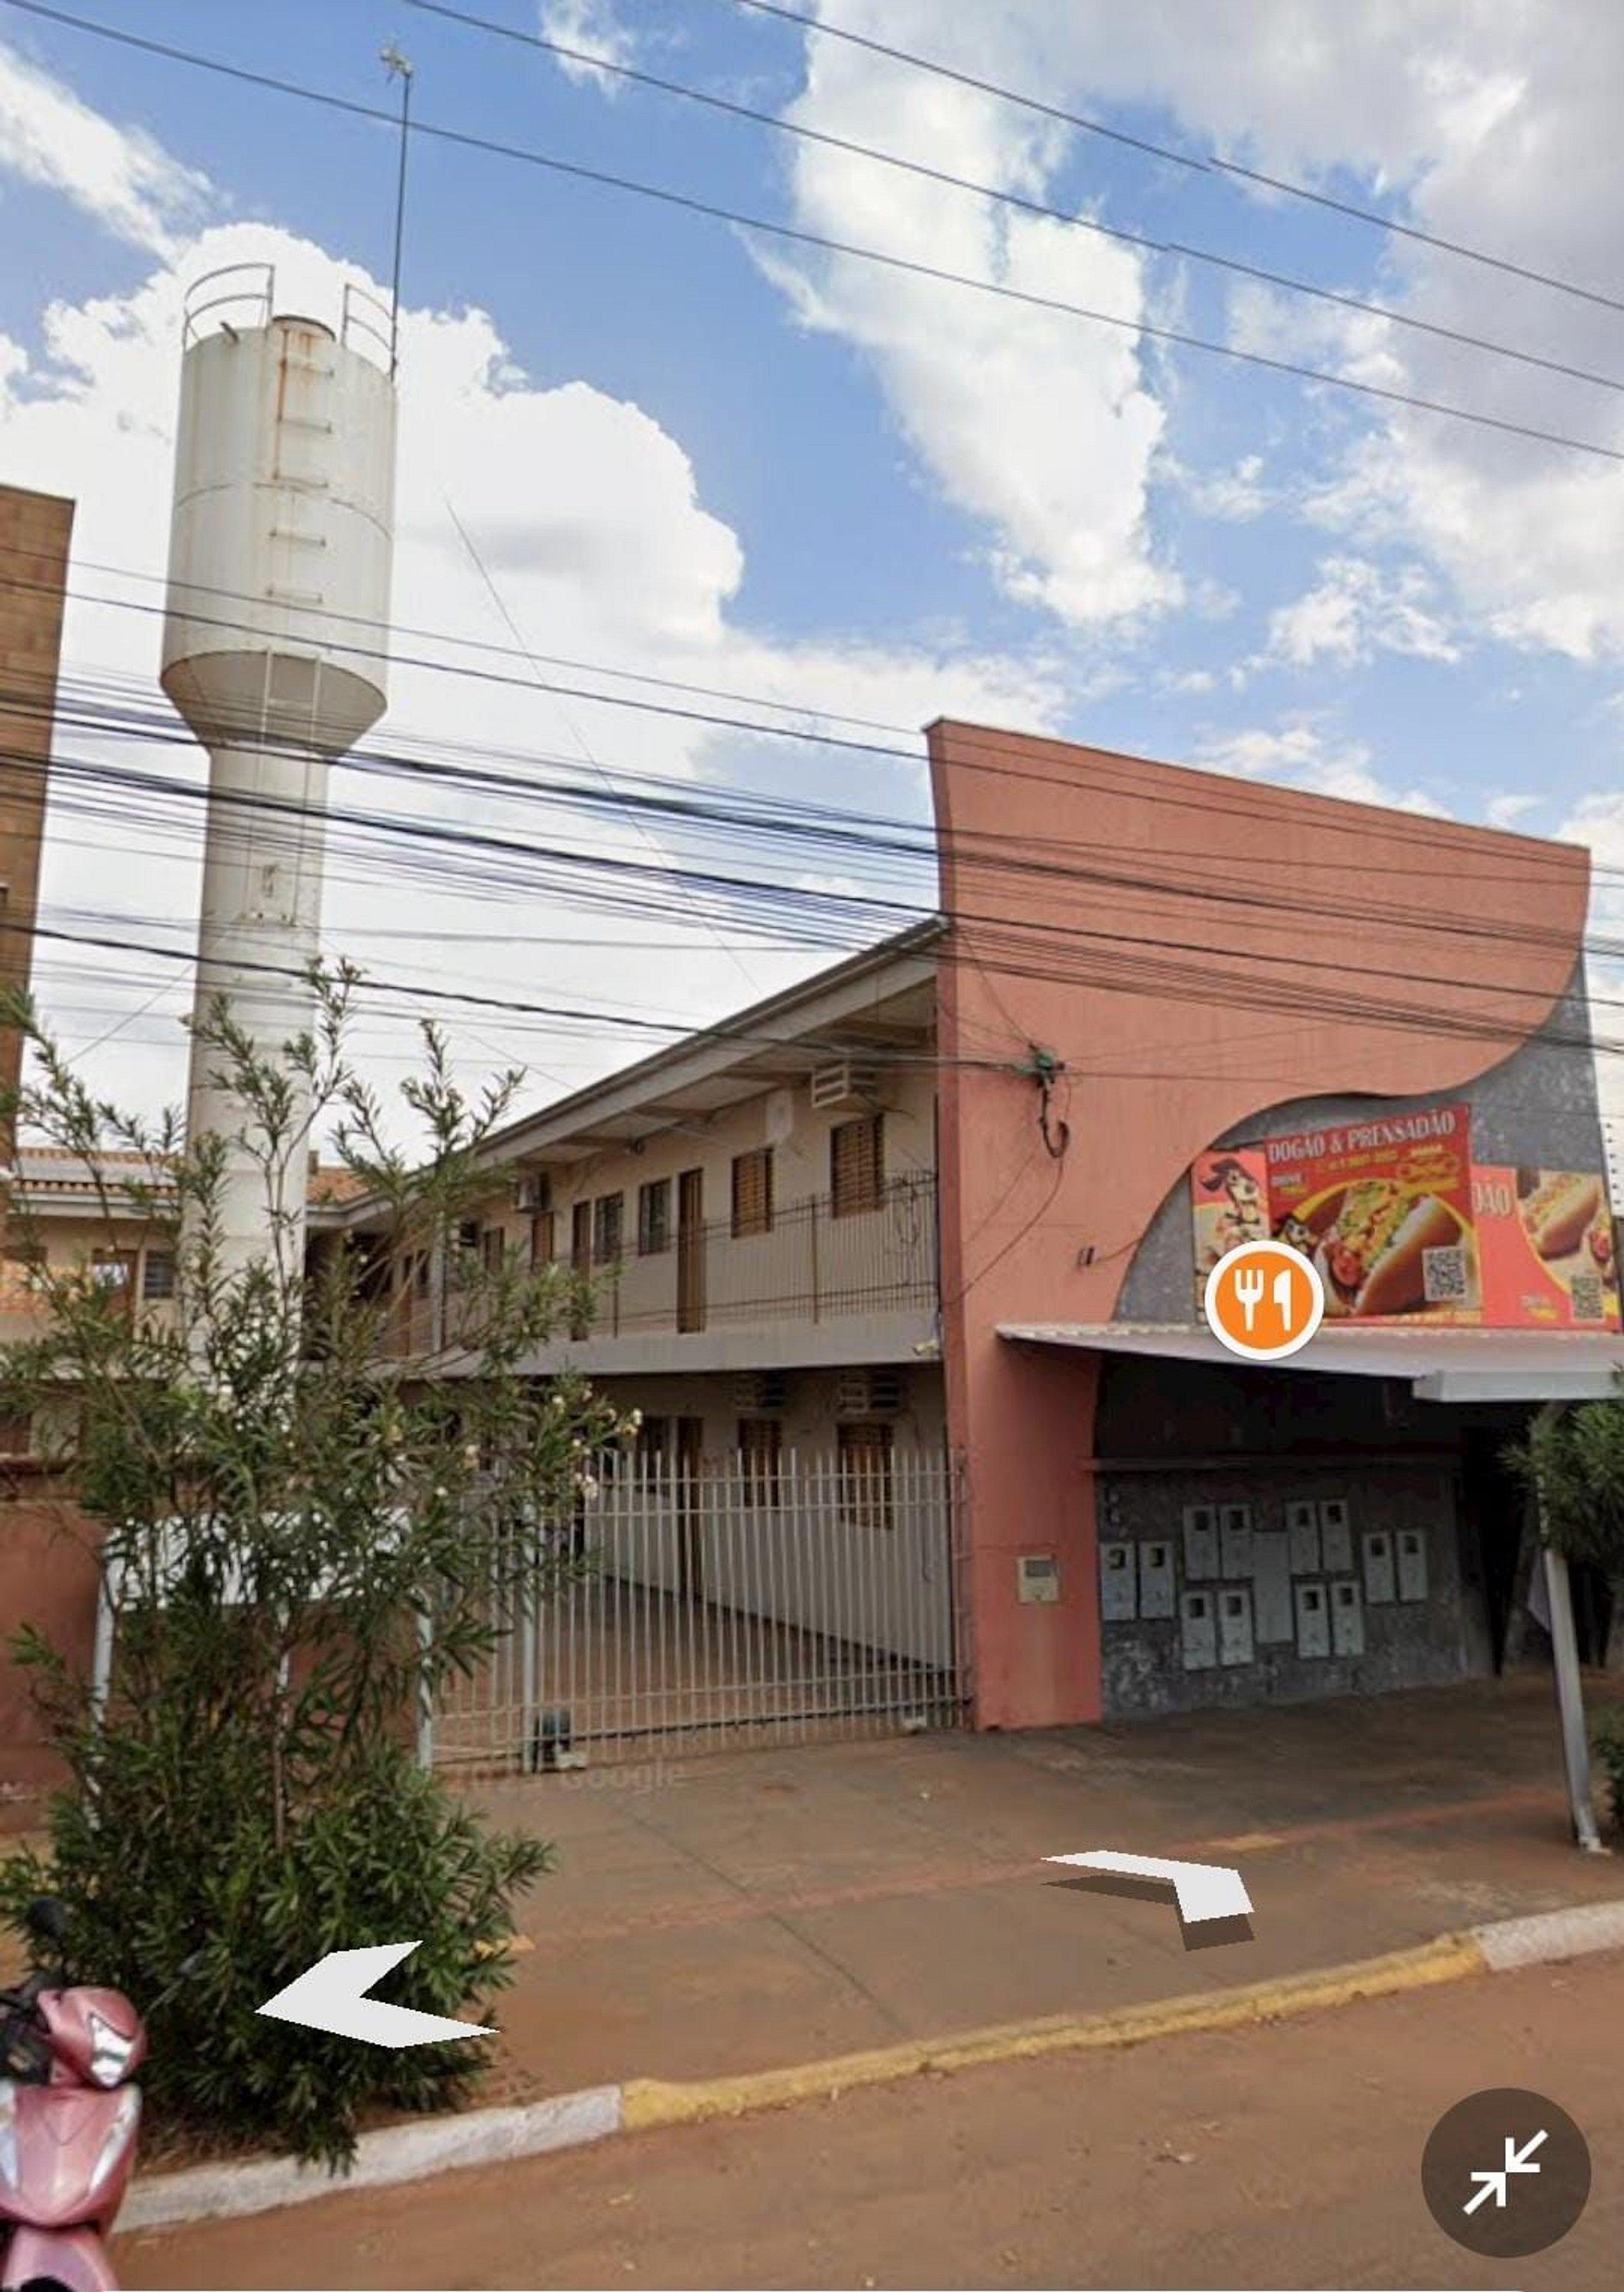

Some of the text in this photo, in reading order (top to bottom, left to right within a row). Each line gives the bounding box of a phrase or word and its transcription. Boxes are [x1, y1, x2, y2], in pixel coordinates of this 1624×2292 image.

[1269, 1132, 1325, 1162] DOGÃO
[1330, 1131, 1343, 1154] &
[1347, 1109, 1455, 1150] PRENSADÃO
